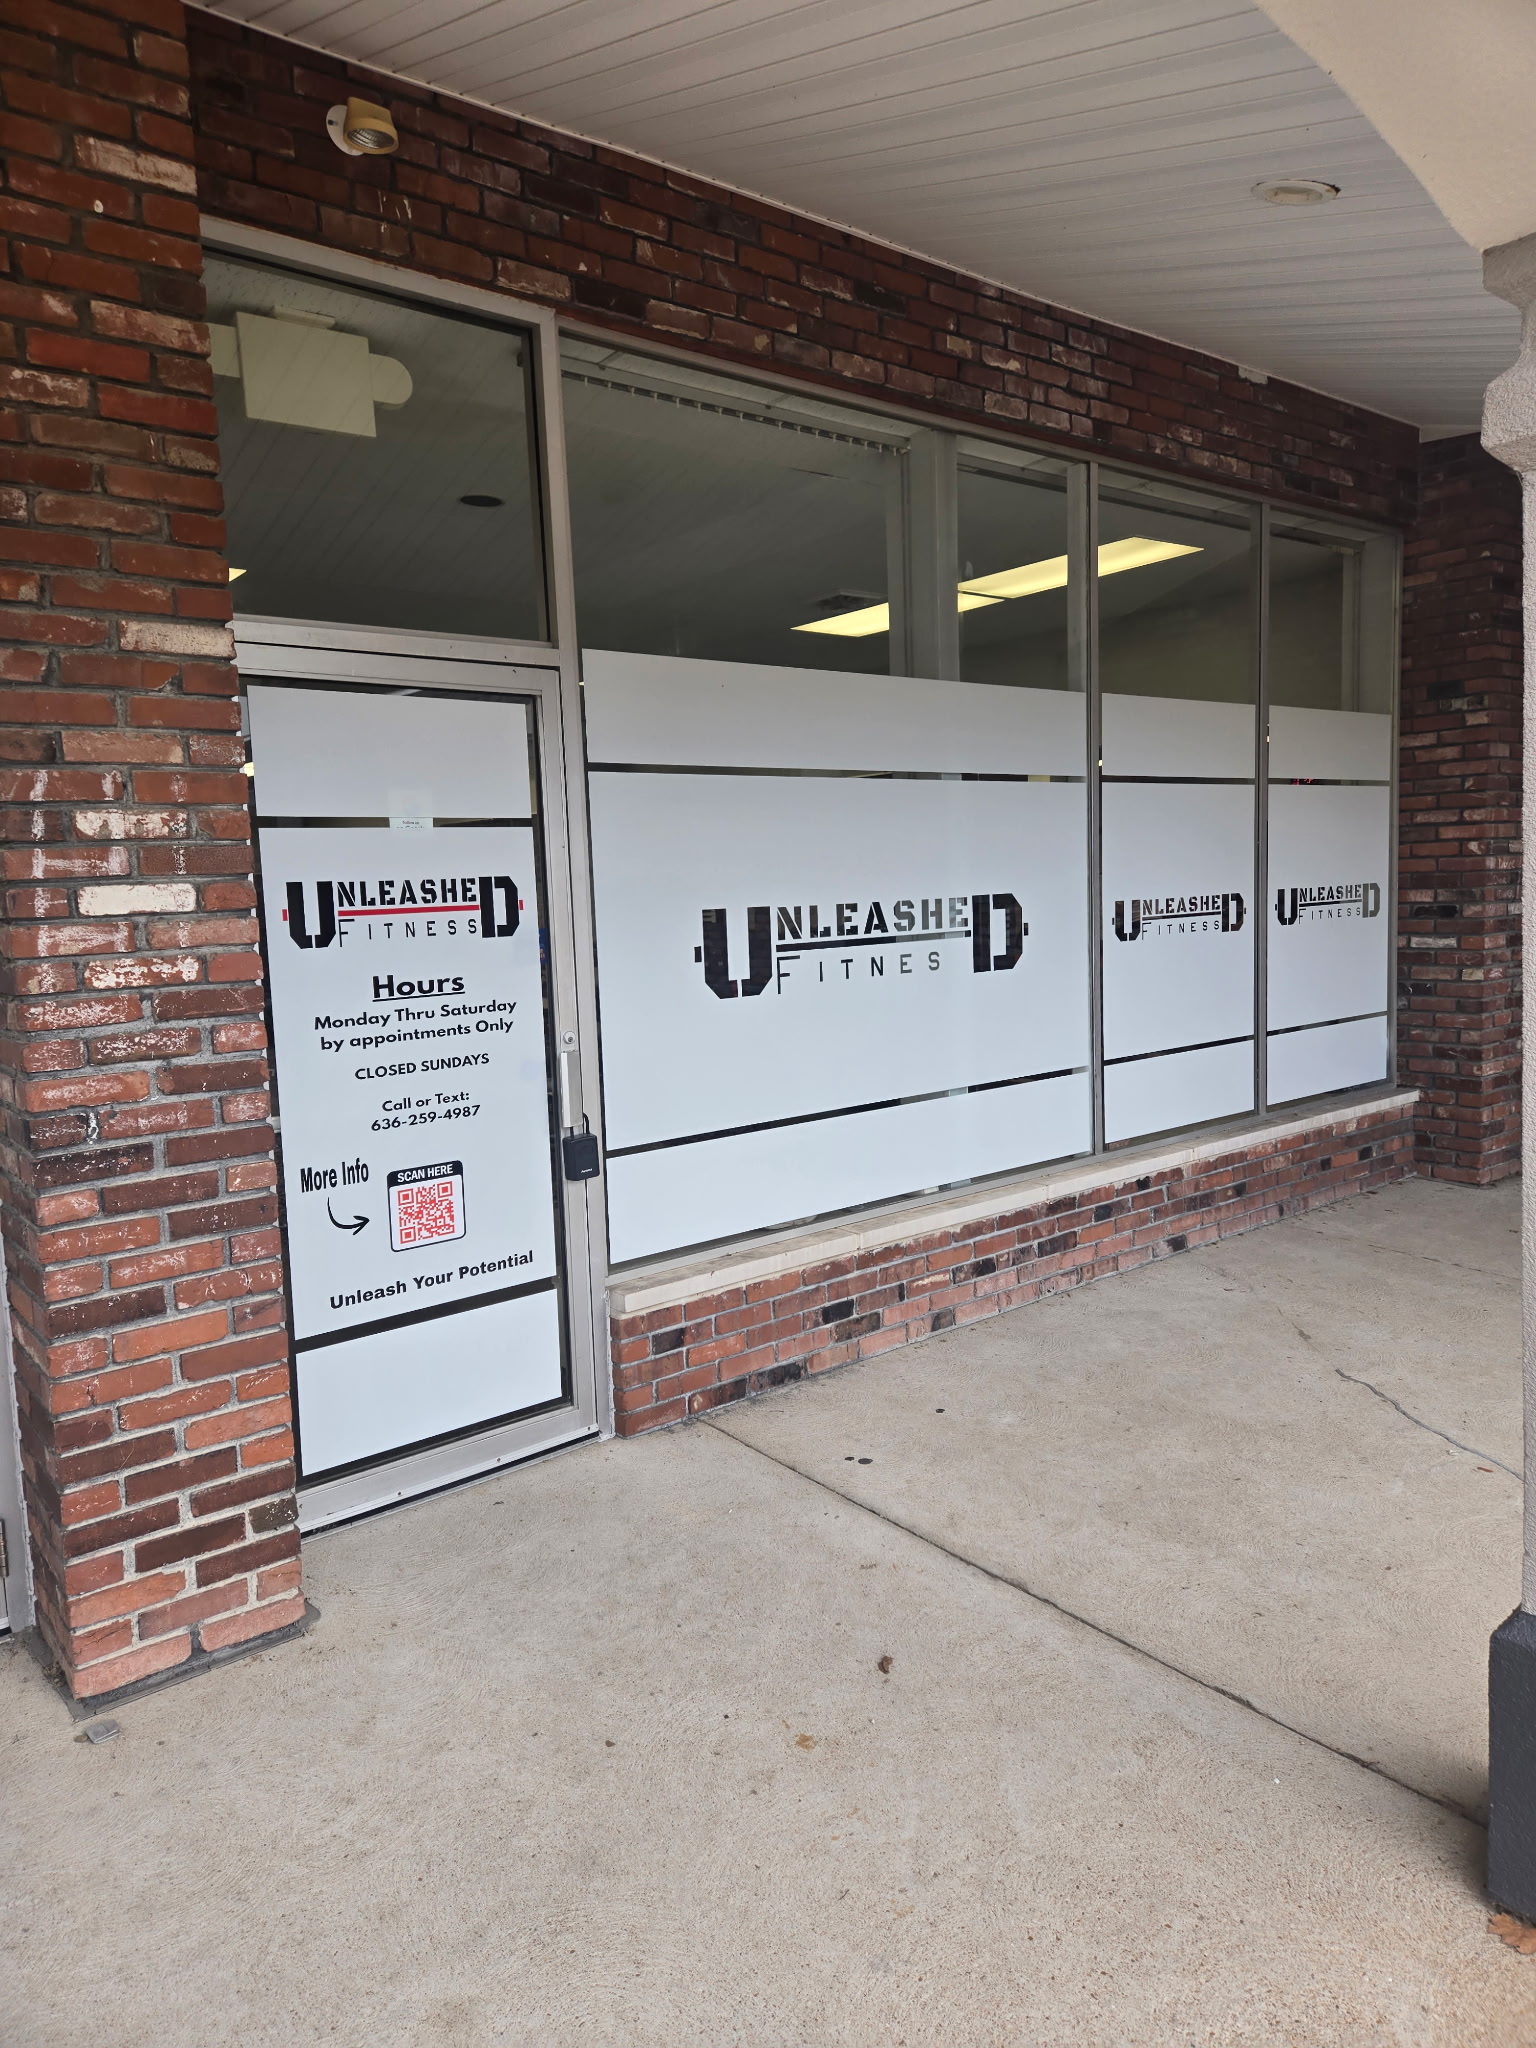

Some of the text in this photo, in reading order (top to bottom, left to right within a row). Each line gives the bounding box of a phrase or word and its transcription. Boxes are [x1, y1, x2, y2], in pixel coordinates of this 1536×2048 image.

[285, 875, 520, 950] UNLEASHED
[1114, 892, 1245, 942] UNLEASHED
[1277, 882, 1381, 926] UNLEASHED
[1299, 906, 1361, 925] FITNESS
[338, 918, 478, 948] FITNESS
[1142, 920, 1220, 940] FITNESS
[701, 892, 1024, 1000] UNLEASHED
[372, 974, 466, 1000] Hours
[776, 951, 941, 995] FITNES
[313, 1000, 517, 1031] Monday Thru Saturday
[320, 1018, 514, 1052] by appointments Only
[354, 1053, 490, 1080] CLOSED SUNDAYS
[382, 1091, 470, 1112] Call or Text:
[371, 1104, 481, 1131] 636-259-4987
[300, 1157, 370, 1193] More Info
[397, 1164, 454, 1183] SCAN HERE
[329, 1250, 534, 1310] Unleash Your Potential
